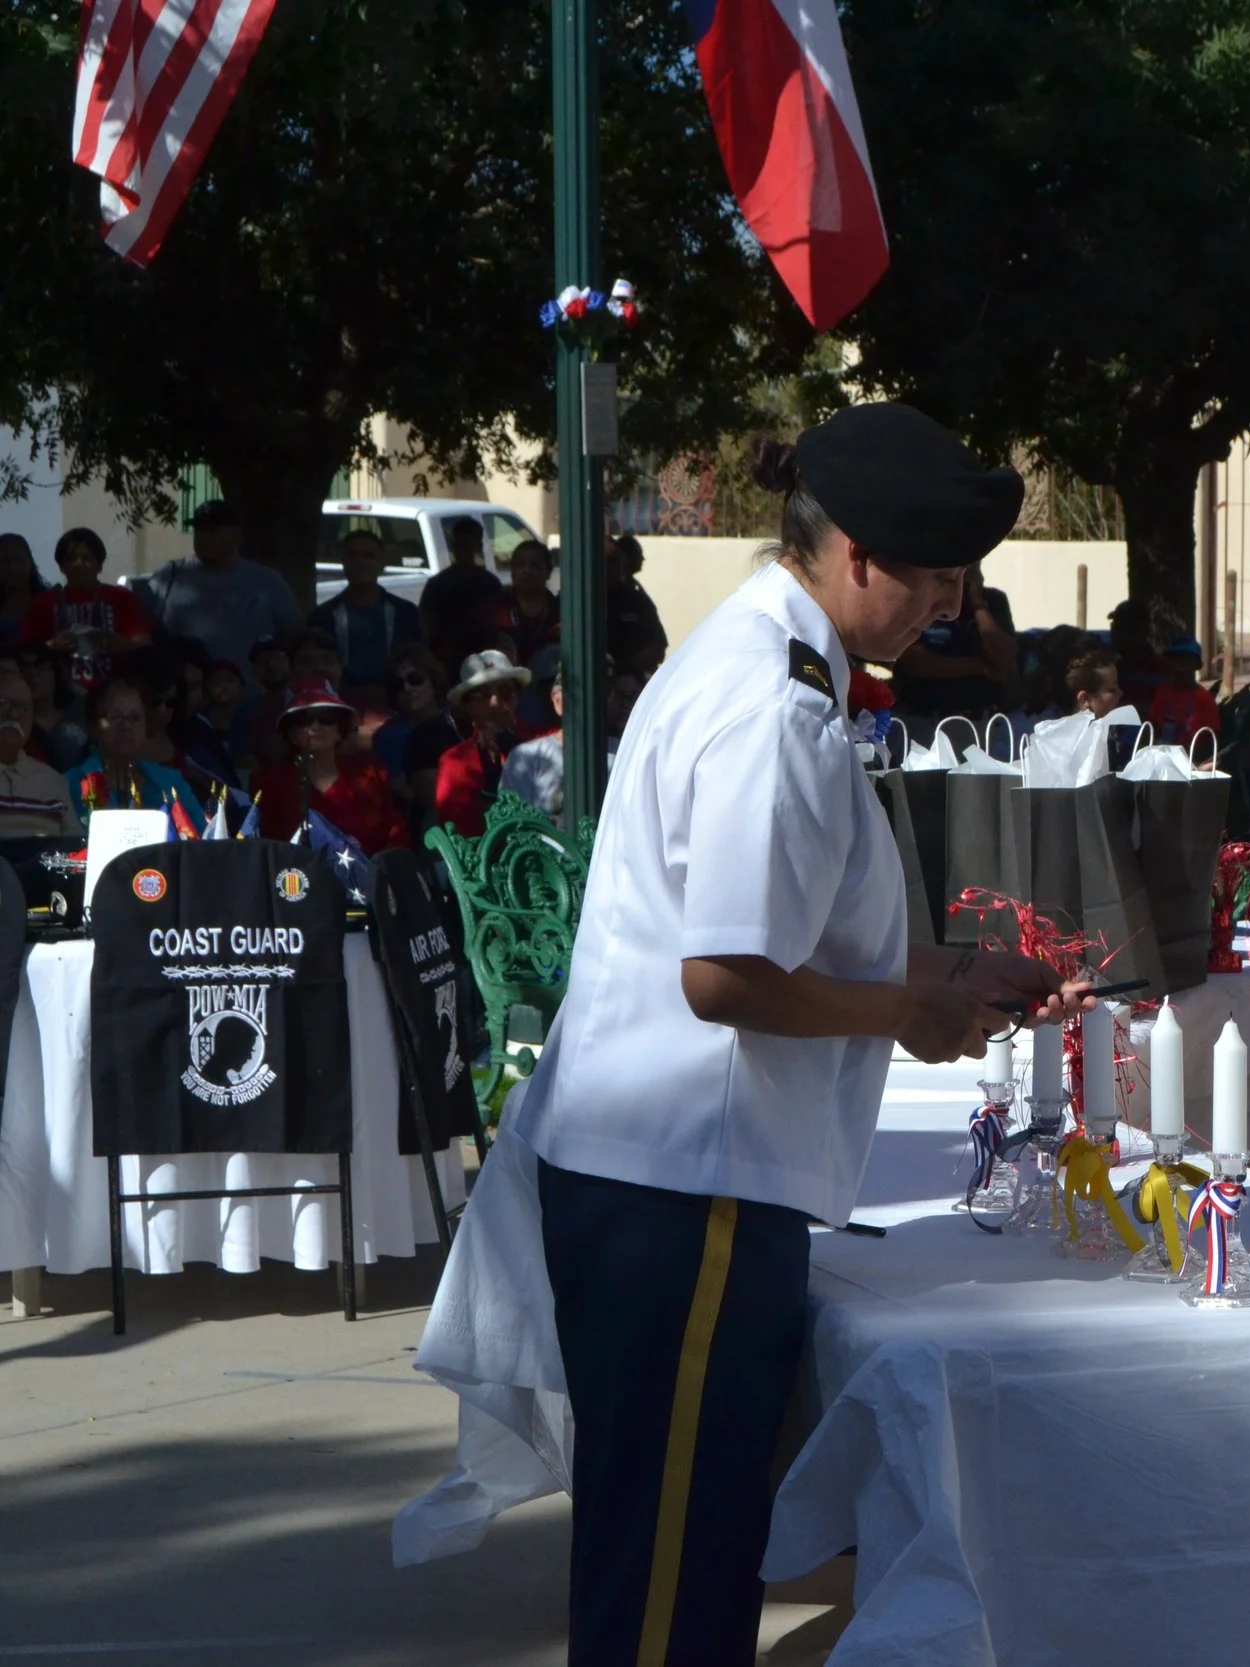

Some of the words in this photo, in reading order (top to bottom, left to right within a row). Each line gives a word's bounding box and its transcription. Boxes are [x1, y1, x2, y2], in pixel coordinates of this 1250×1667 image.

[149, 927, 222, 956] COAST
[230, 925, 304, 955] GUARD
[409, 933, 431, 964] AIR
[180, 1070, 197, 1089] YOU
[191, 1086, 211, 1102] ARE
[210, 1094, 230, 1106] NOT
[231, 1069, 277, 1105] FORGOTTEN
